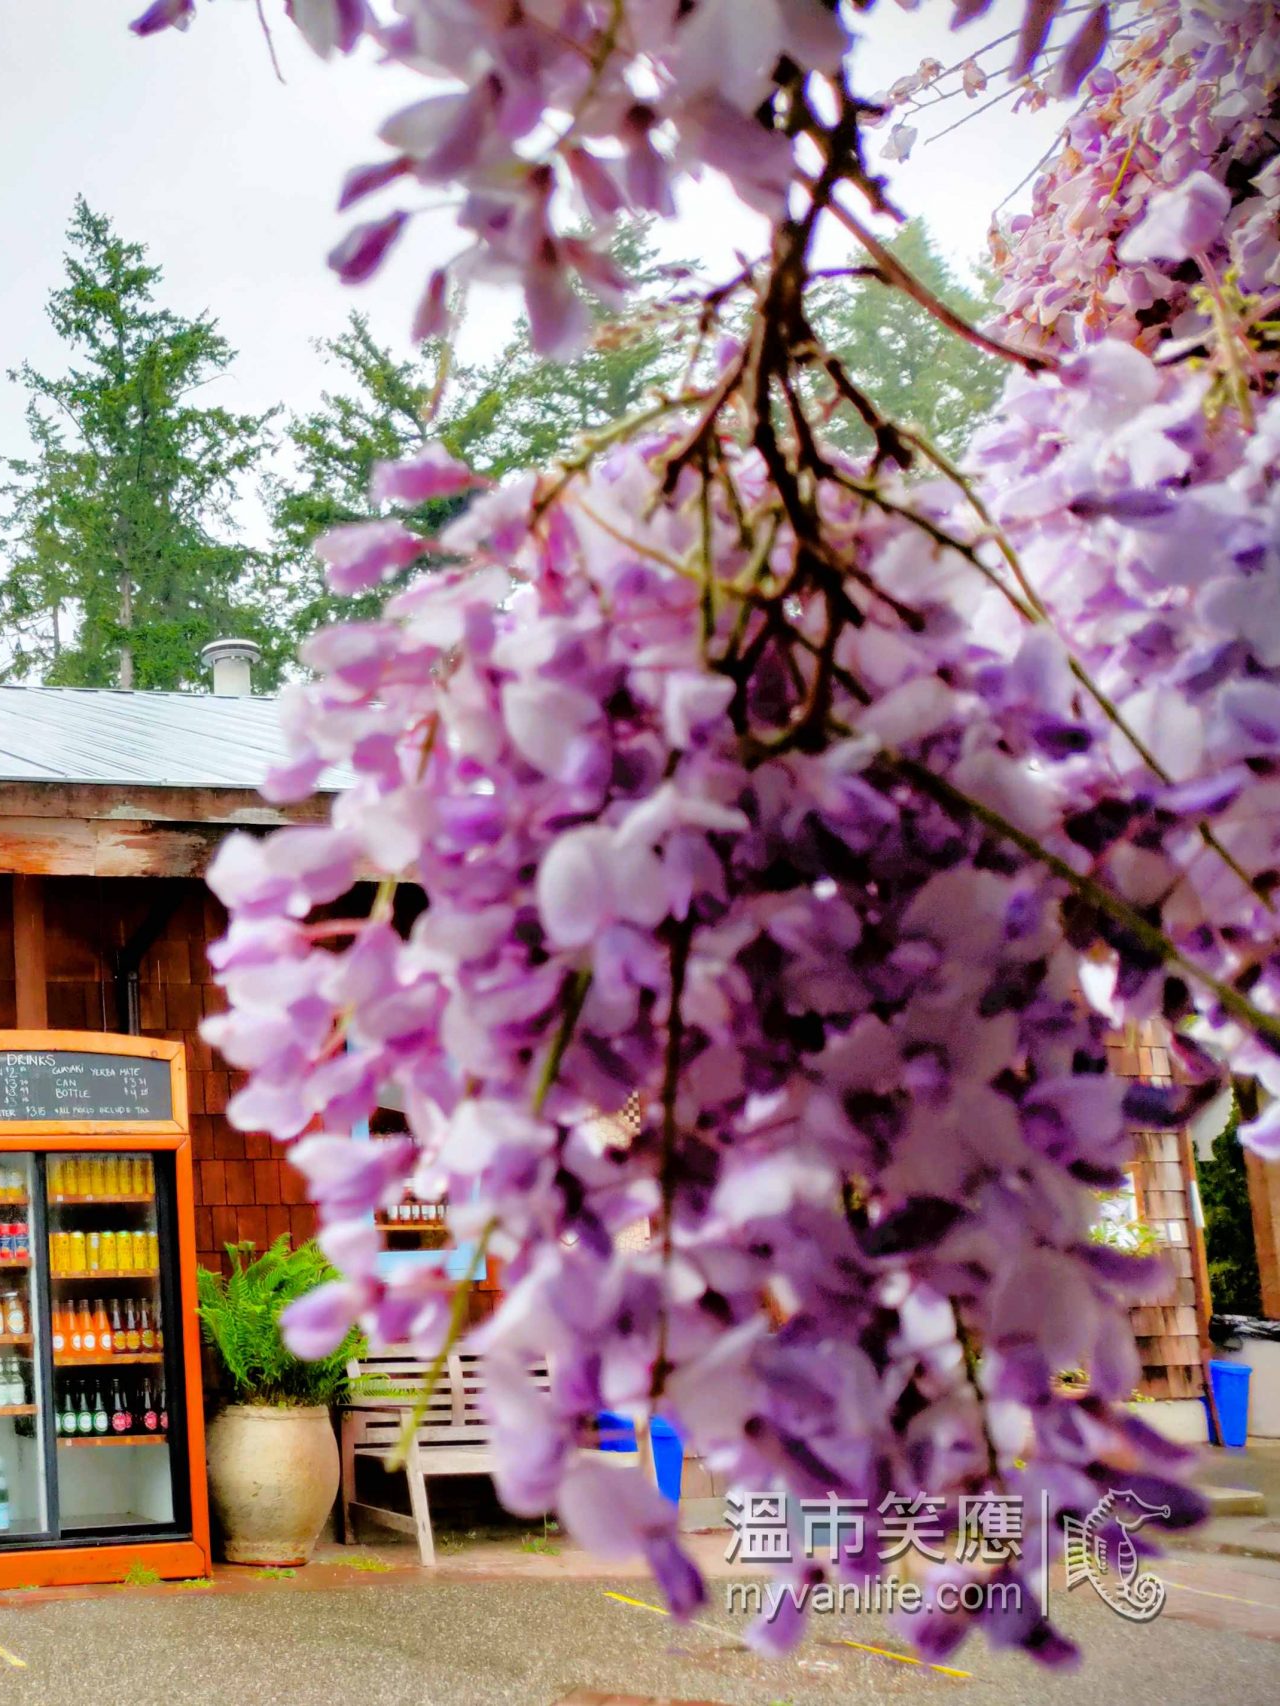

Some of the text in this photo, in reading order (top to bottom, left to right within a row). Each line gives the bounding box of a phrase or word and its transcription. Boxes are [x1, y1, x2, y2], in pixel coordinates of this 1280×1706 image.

[6, 1054, 56, 1067] DRINKS
[90, 1067, 116, 1077] YERBA
[119, 1067, 141, 1076] MATE
[55, 1079, 77, 1087] CAN
[55, 1088, 91, 1099] BOTTLE
